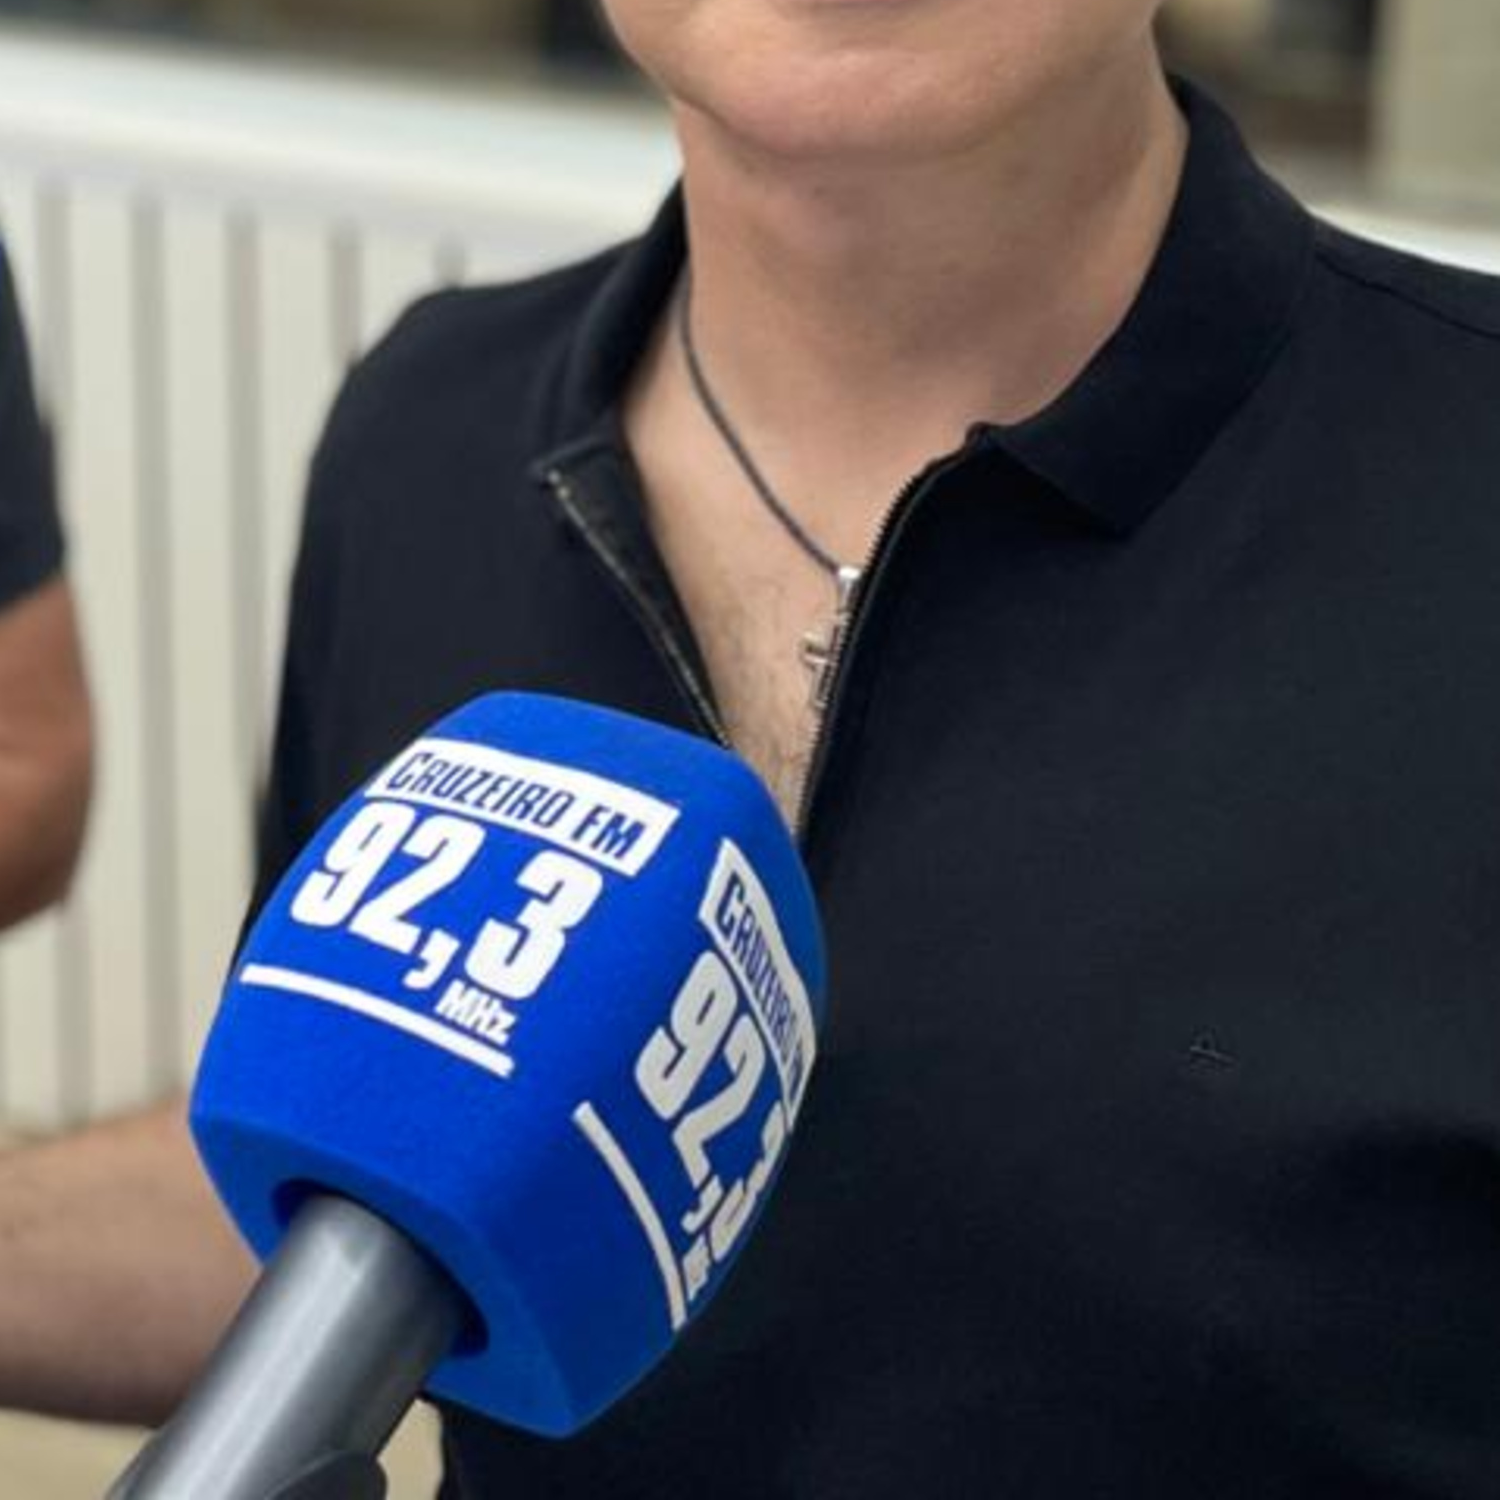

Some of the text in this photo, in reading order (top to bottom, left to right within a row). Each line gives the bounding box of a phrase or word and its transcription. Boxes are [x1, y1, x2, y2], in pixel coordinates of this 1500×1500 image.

[386, 751, 646, 860] CRUZEIRO FM
[290, 800, 603, 1001] 92,3
[434, 979, 518, 1046] MHz
